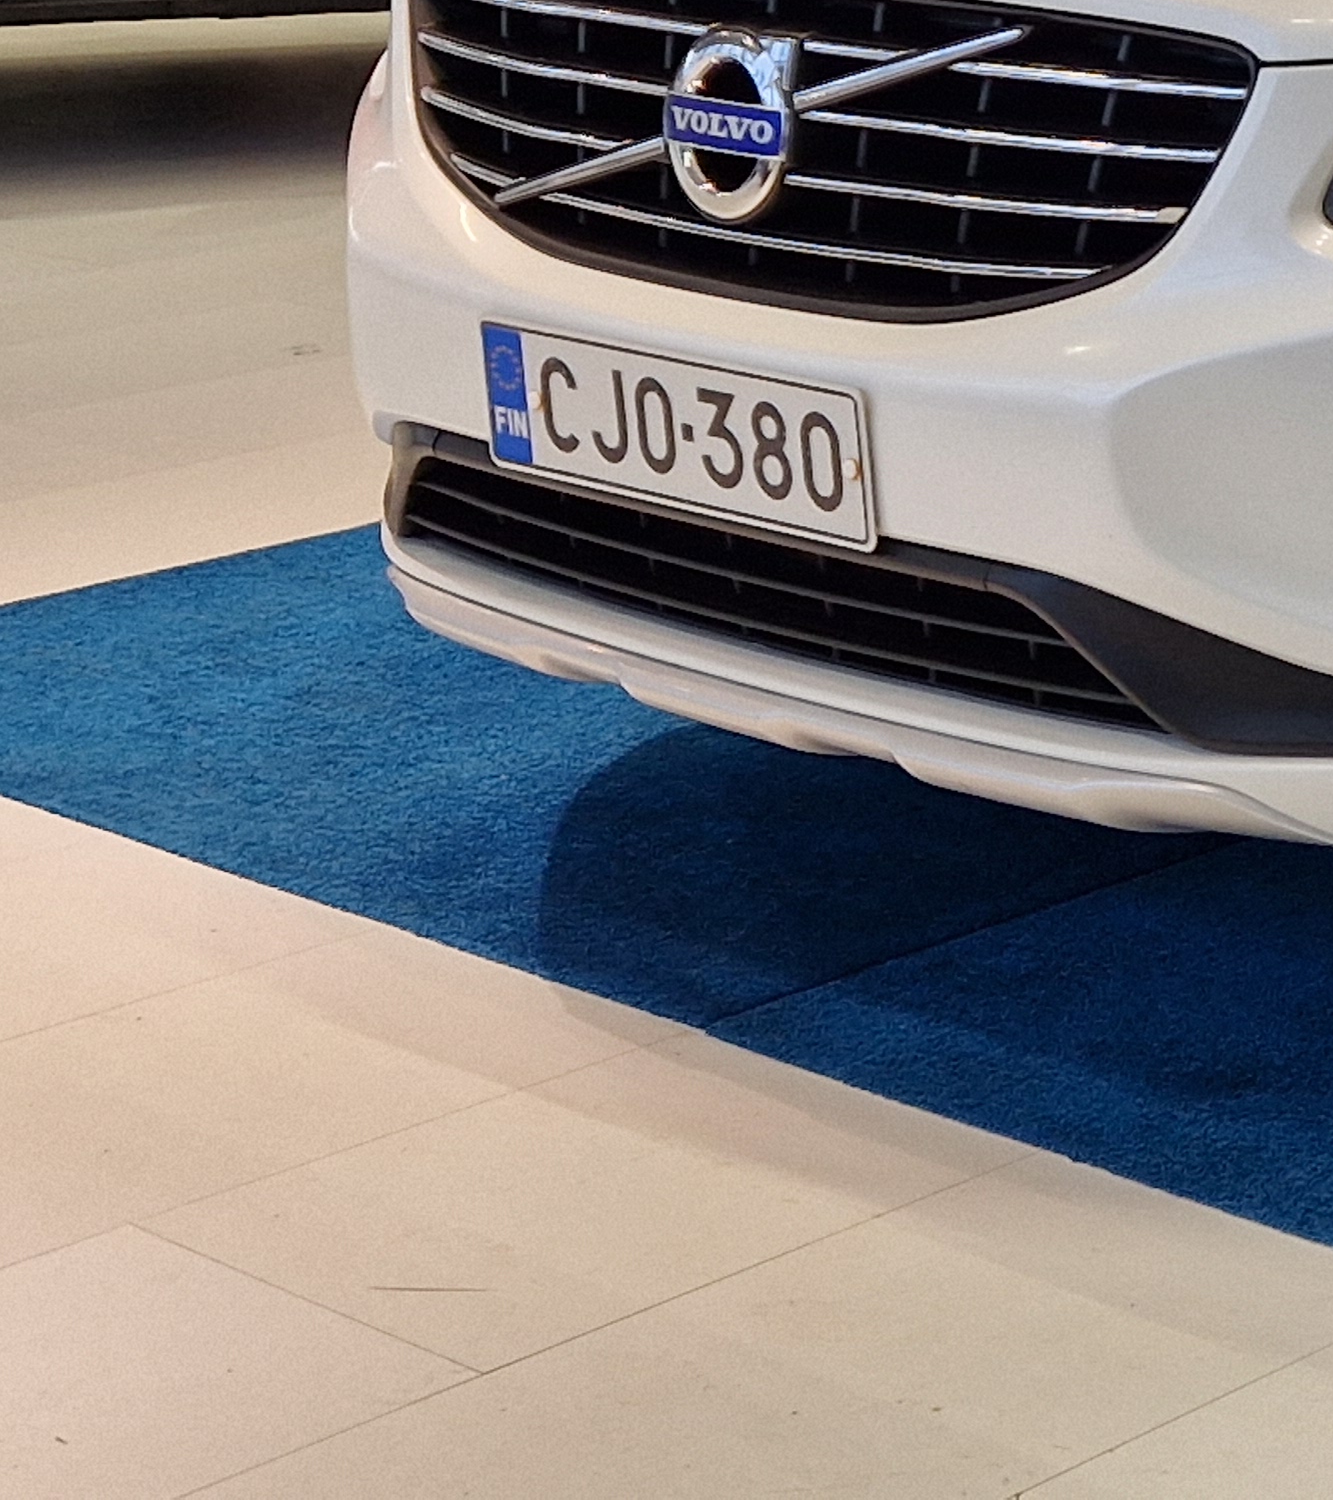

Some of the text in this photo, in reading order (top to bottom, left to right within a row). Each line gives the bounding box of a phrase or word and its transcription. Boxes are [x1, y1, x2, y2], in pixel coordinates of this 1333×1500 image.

[670, 104, 773, 145] VOLVO
[494, 407, 530, 439] FIN
[539, 356, 844, 512] CJO-380
